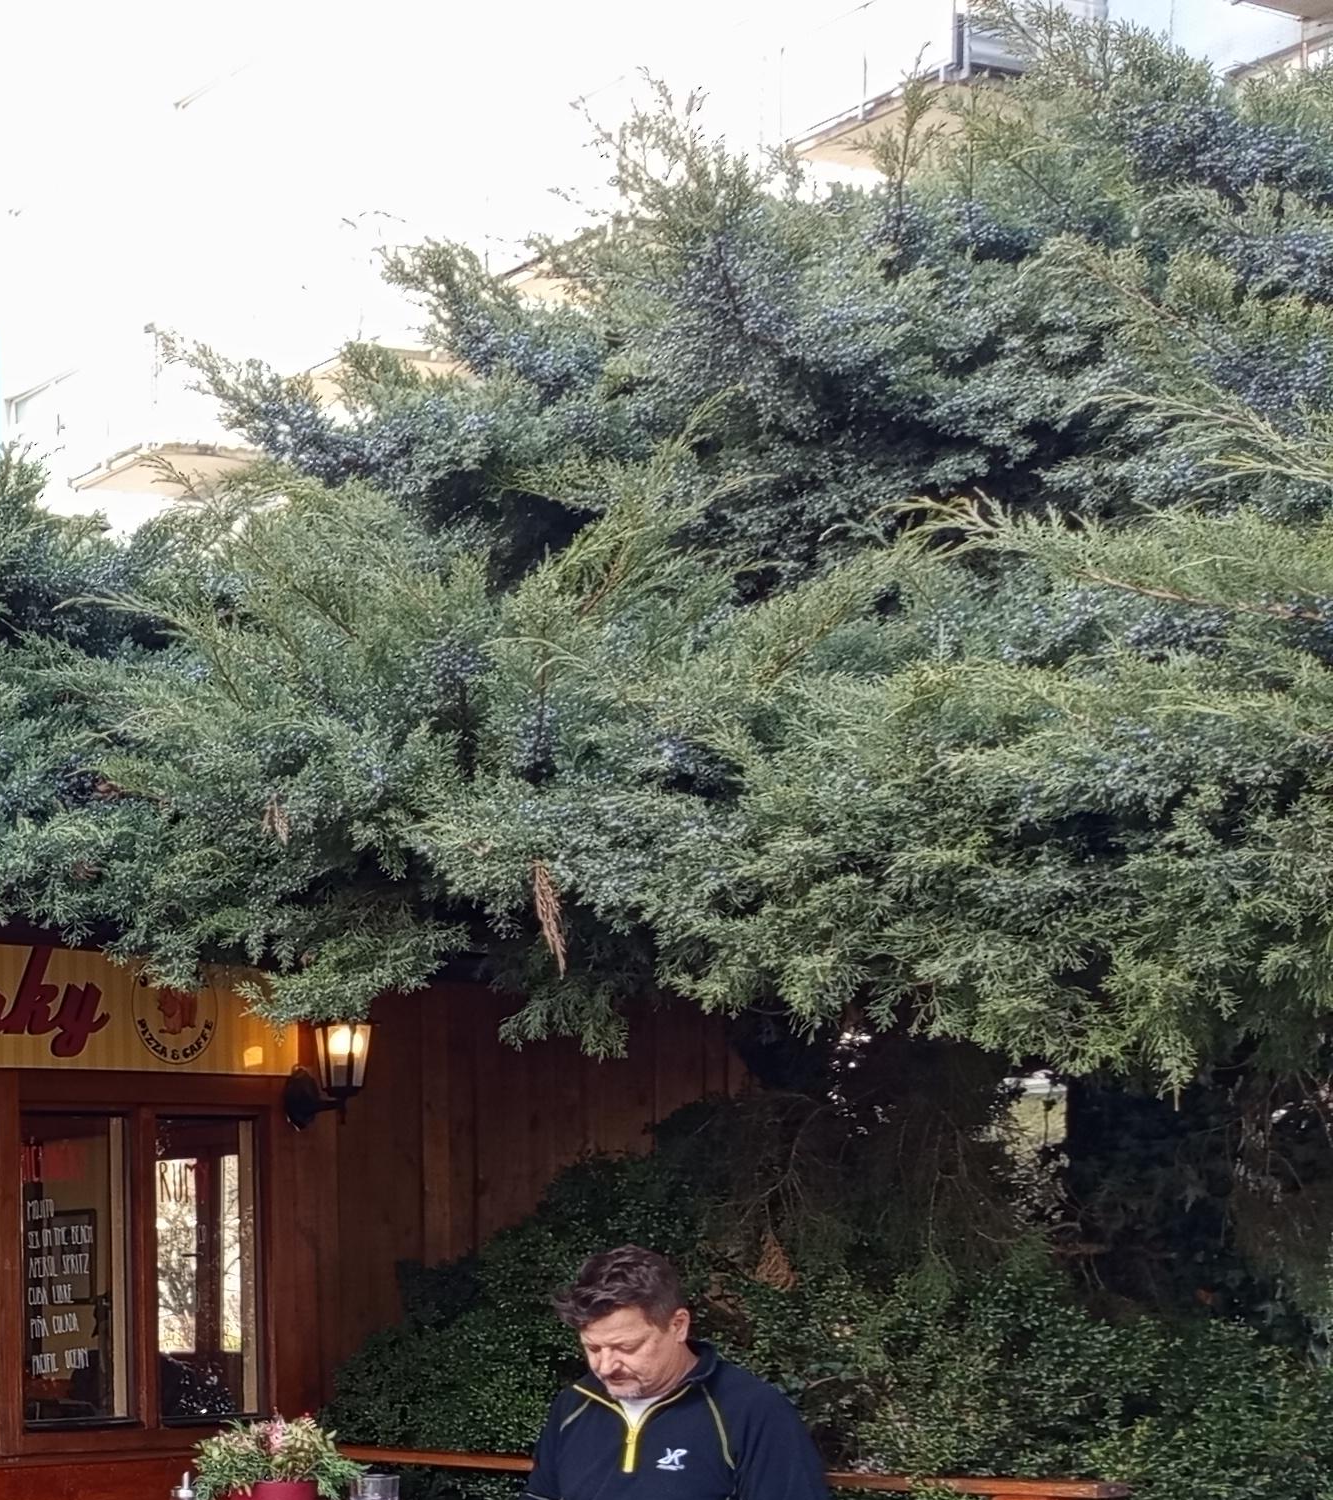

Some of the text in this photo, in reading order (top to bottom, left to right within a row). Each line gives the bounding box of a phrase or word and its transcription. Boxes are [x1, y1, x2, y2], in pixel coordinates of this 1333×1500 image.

[137, 1019, 168, 1058] PIZZA
[182, 1019, 214, 1059] CAFFE
[28, 1253, 90, 1278] APEROL SPRITZ
[28, 1286, 48, 1305] CUBA
[52, 1312, 80, 1334] COLADA
